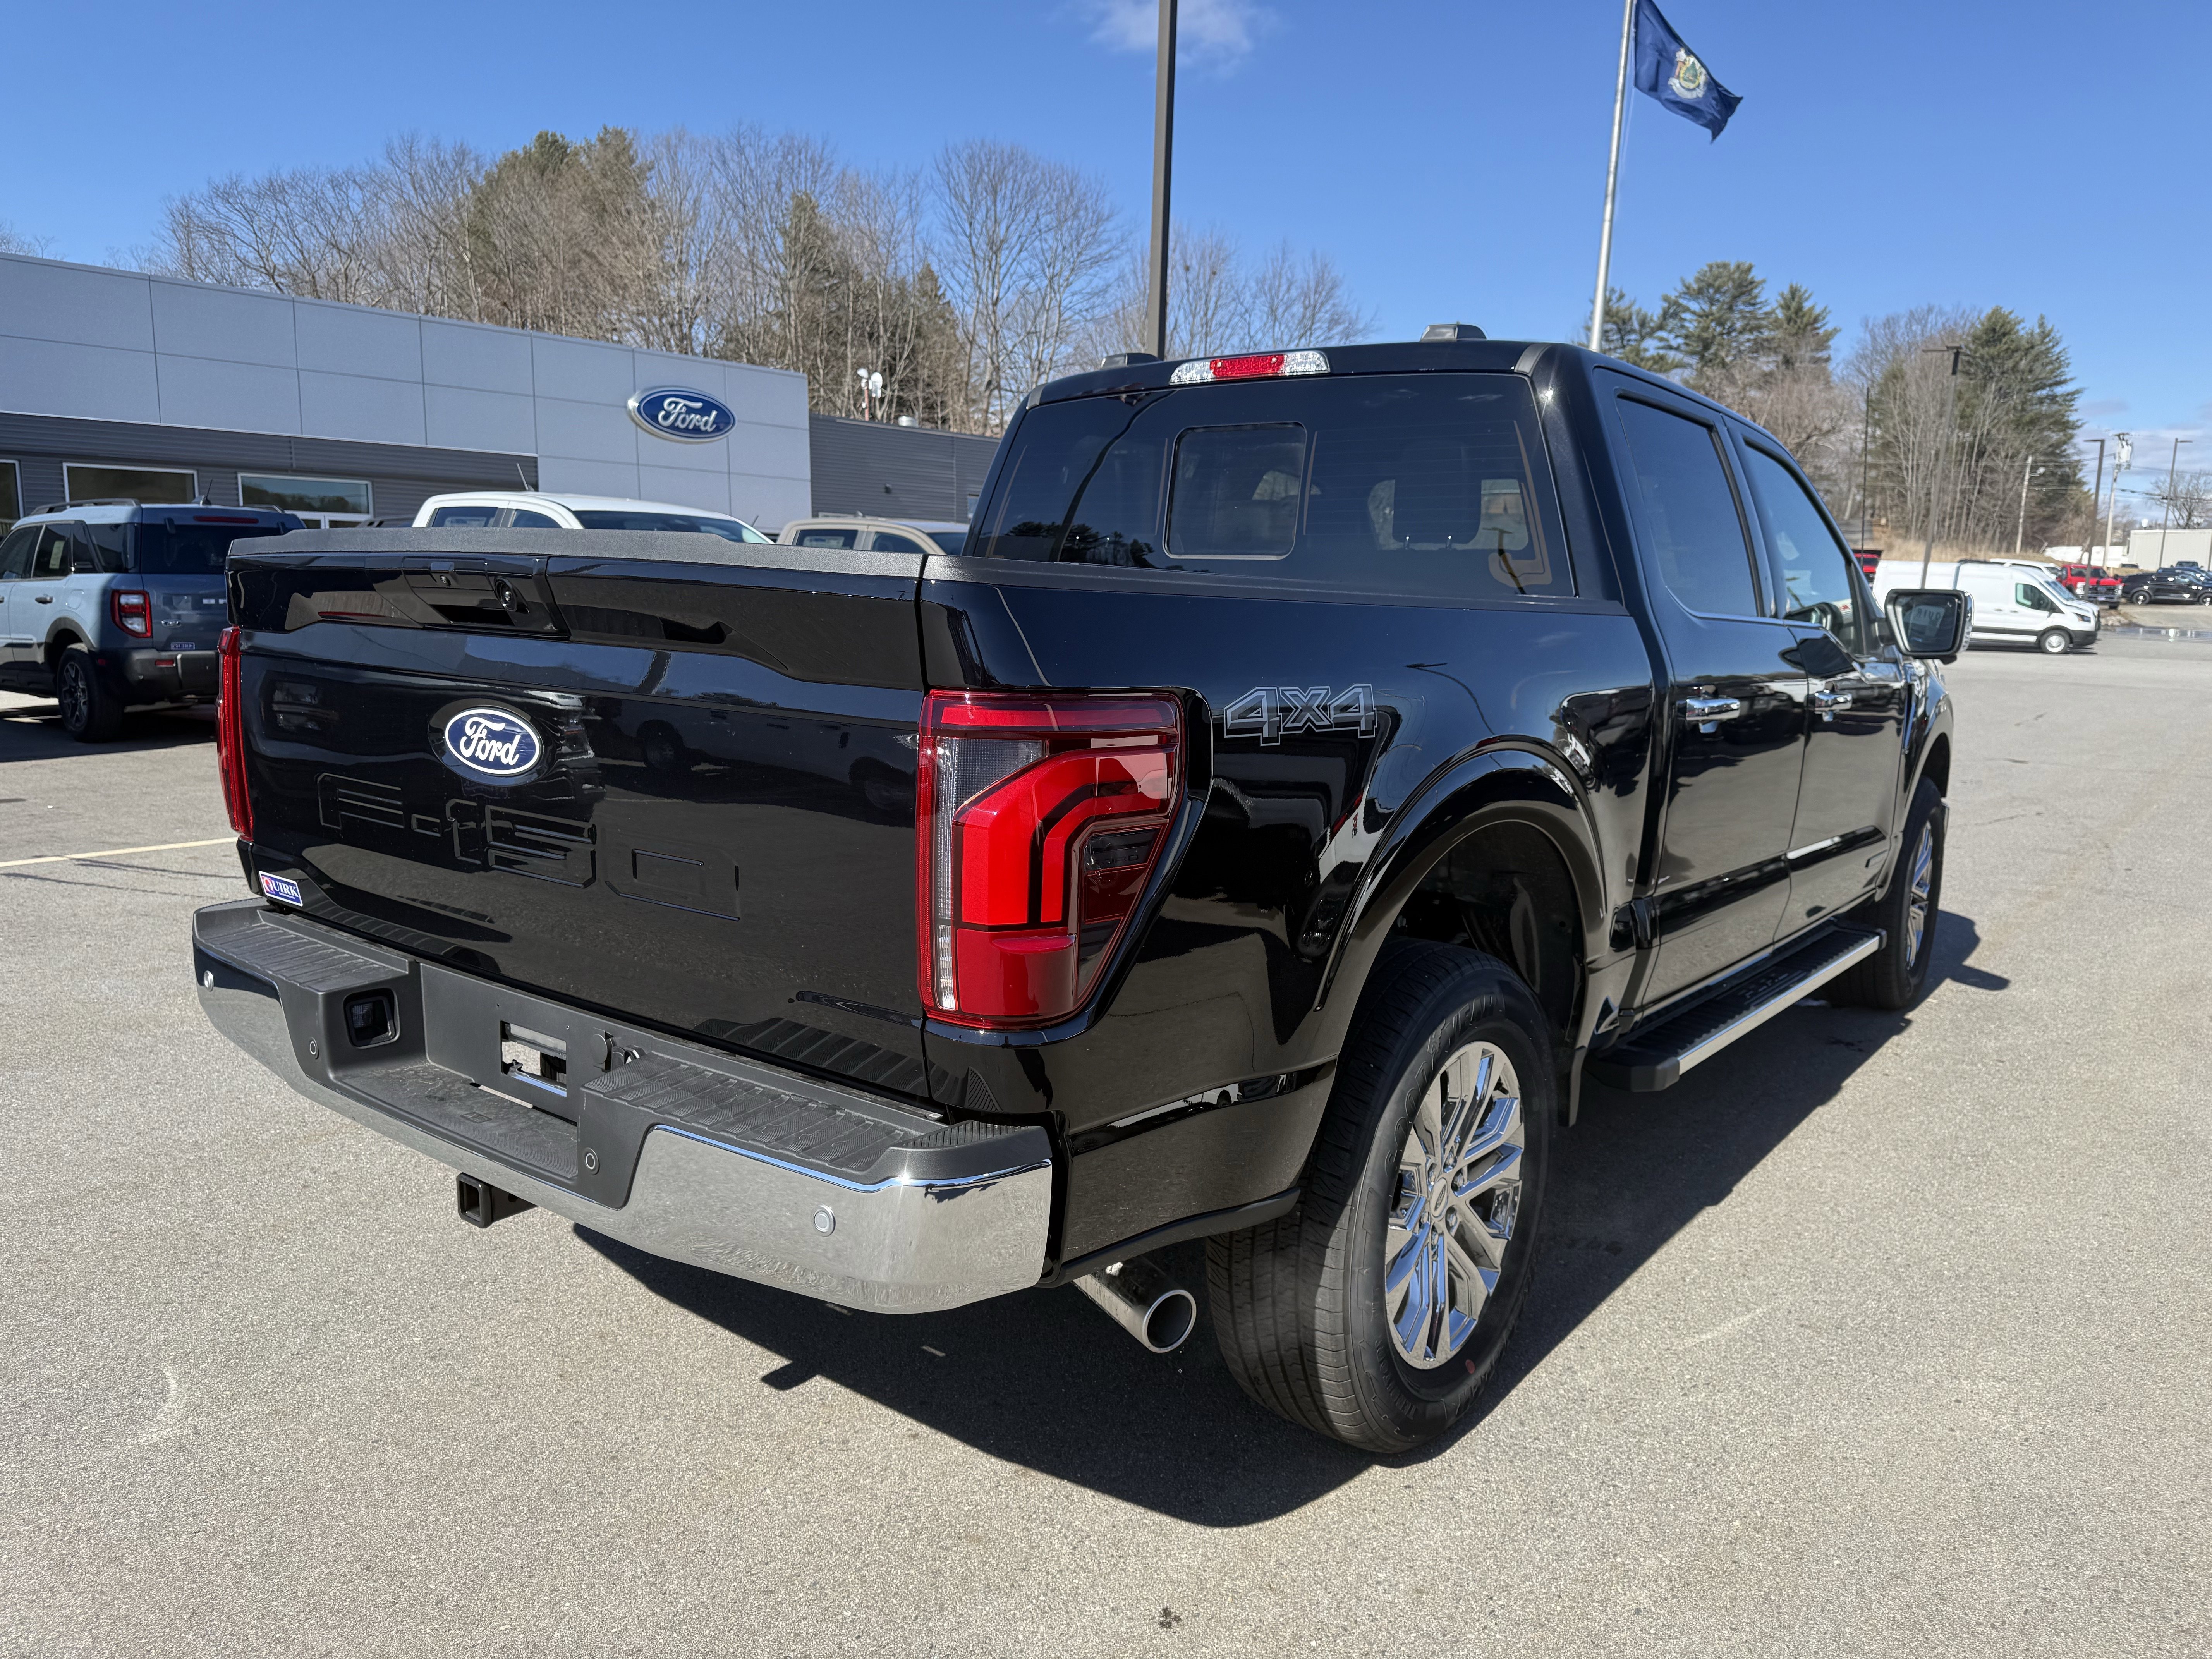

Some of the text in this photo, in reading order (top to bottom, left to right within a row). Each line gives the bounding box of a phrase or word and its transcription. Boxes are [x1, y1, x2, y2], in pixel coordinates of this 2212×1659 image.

[658, 397, 718, 432] Ford
[460, 716, 521, 766] Ford
[317, 772, 740, 921] F-150
[262, 876, 299, 898] QUIRK
